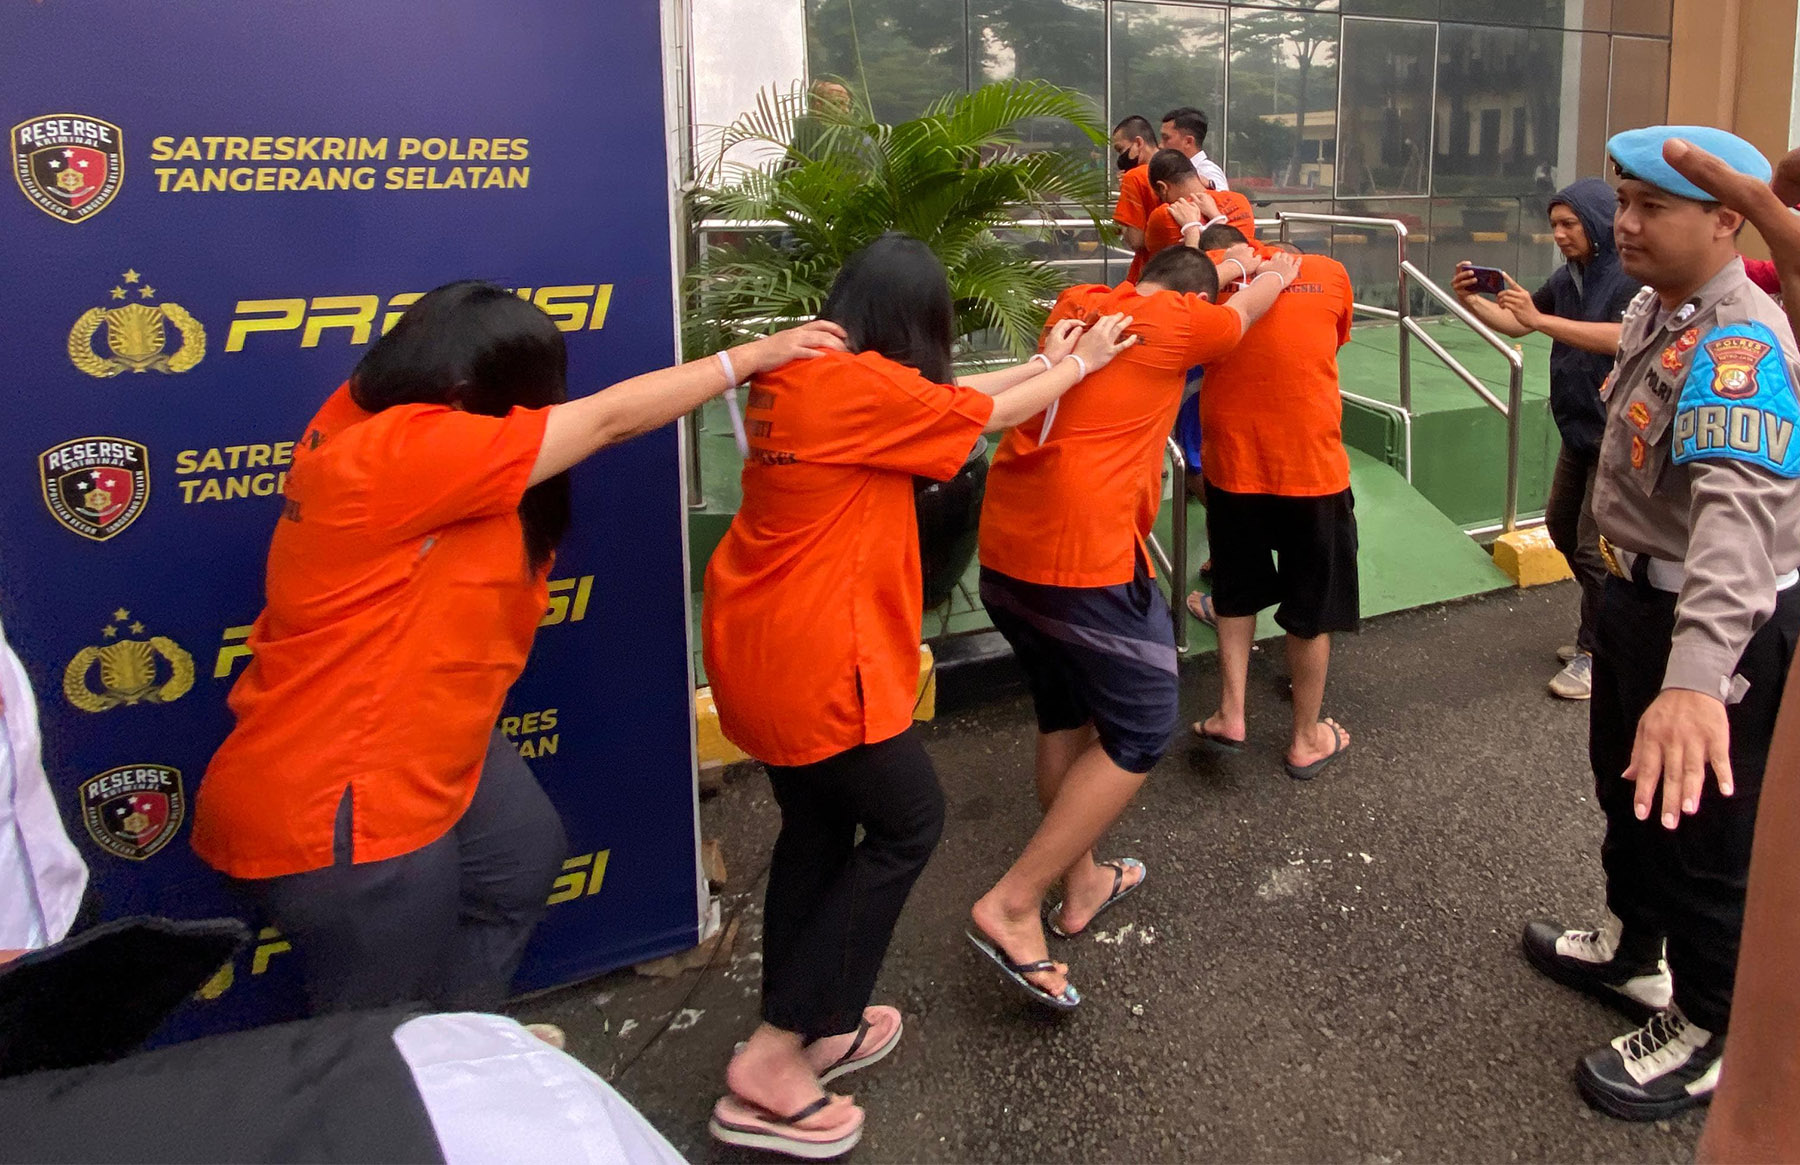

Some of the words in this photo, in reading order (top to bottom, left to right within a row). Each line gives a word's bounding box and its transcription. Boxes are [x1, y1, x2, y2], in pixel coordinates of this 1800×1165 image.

[20, 119, 112, 145] RESERSE
[34, 136, 99, 148] KRIMINAL
[150, 136, 388, 161] SATRESKRIM
[398, 137, 529, 161] POLRES
[154, 167, 376, 192] TANGERANG
[384, 166, 530, 190] SELATAN
[1673, 404, 1795, 466] PROV
[49, 442, 138, 470] RESERSE
[62, 457, 125, 471] KRIMINAL
[175, 441, 295, 474] SATRE
[501, 708, 558, 737] RES
[88, 769, 172, 799] RESERSE
